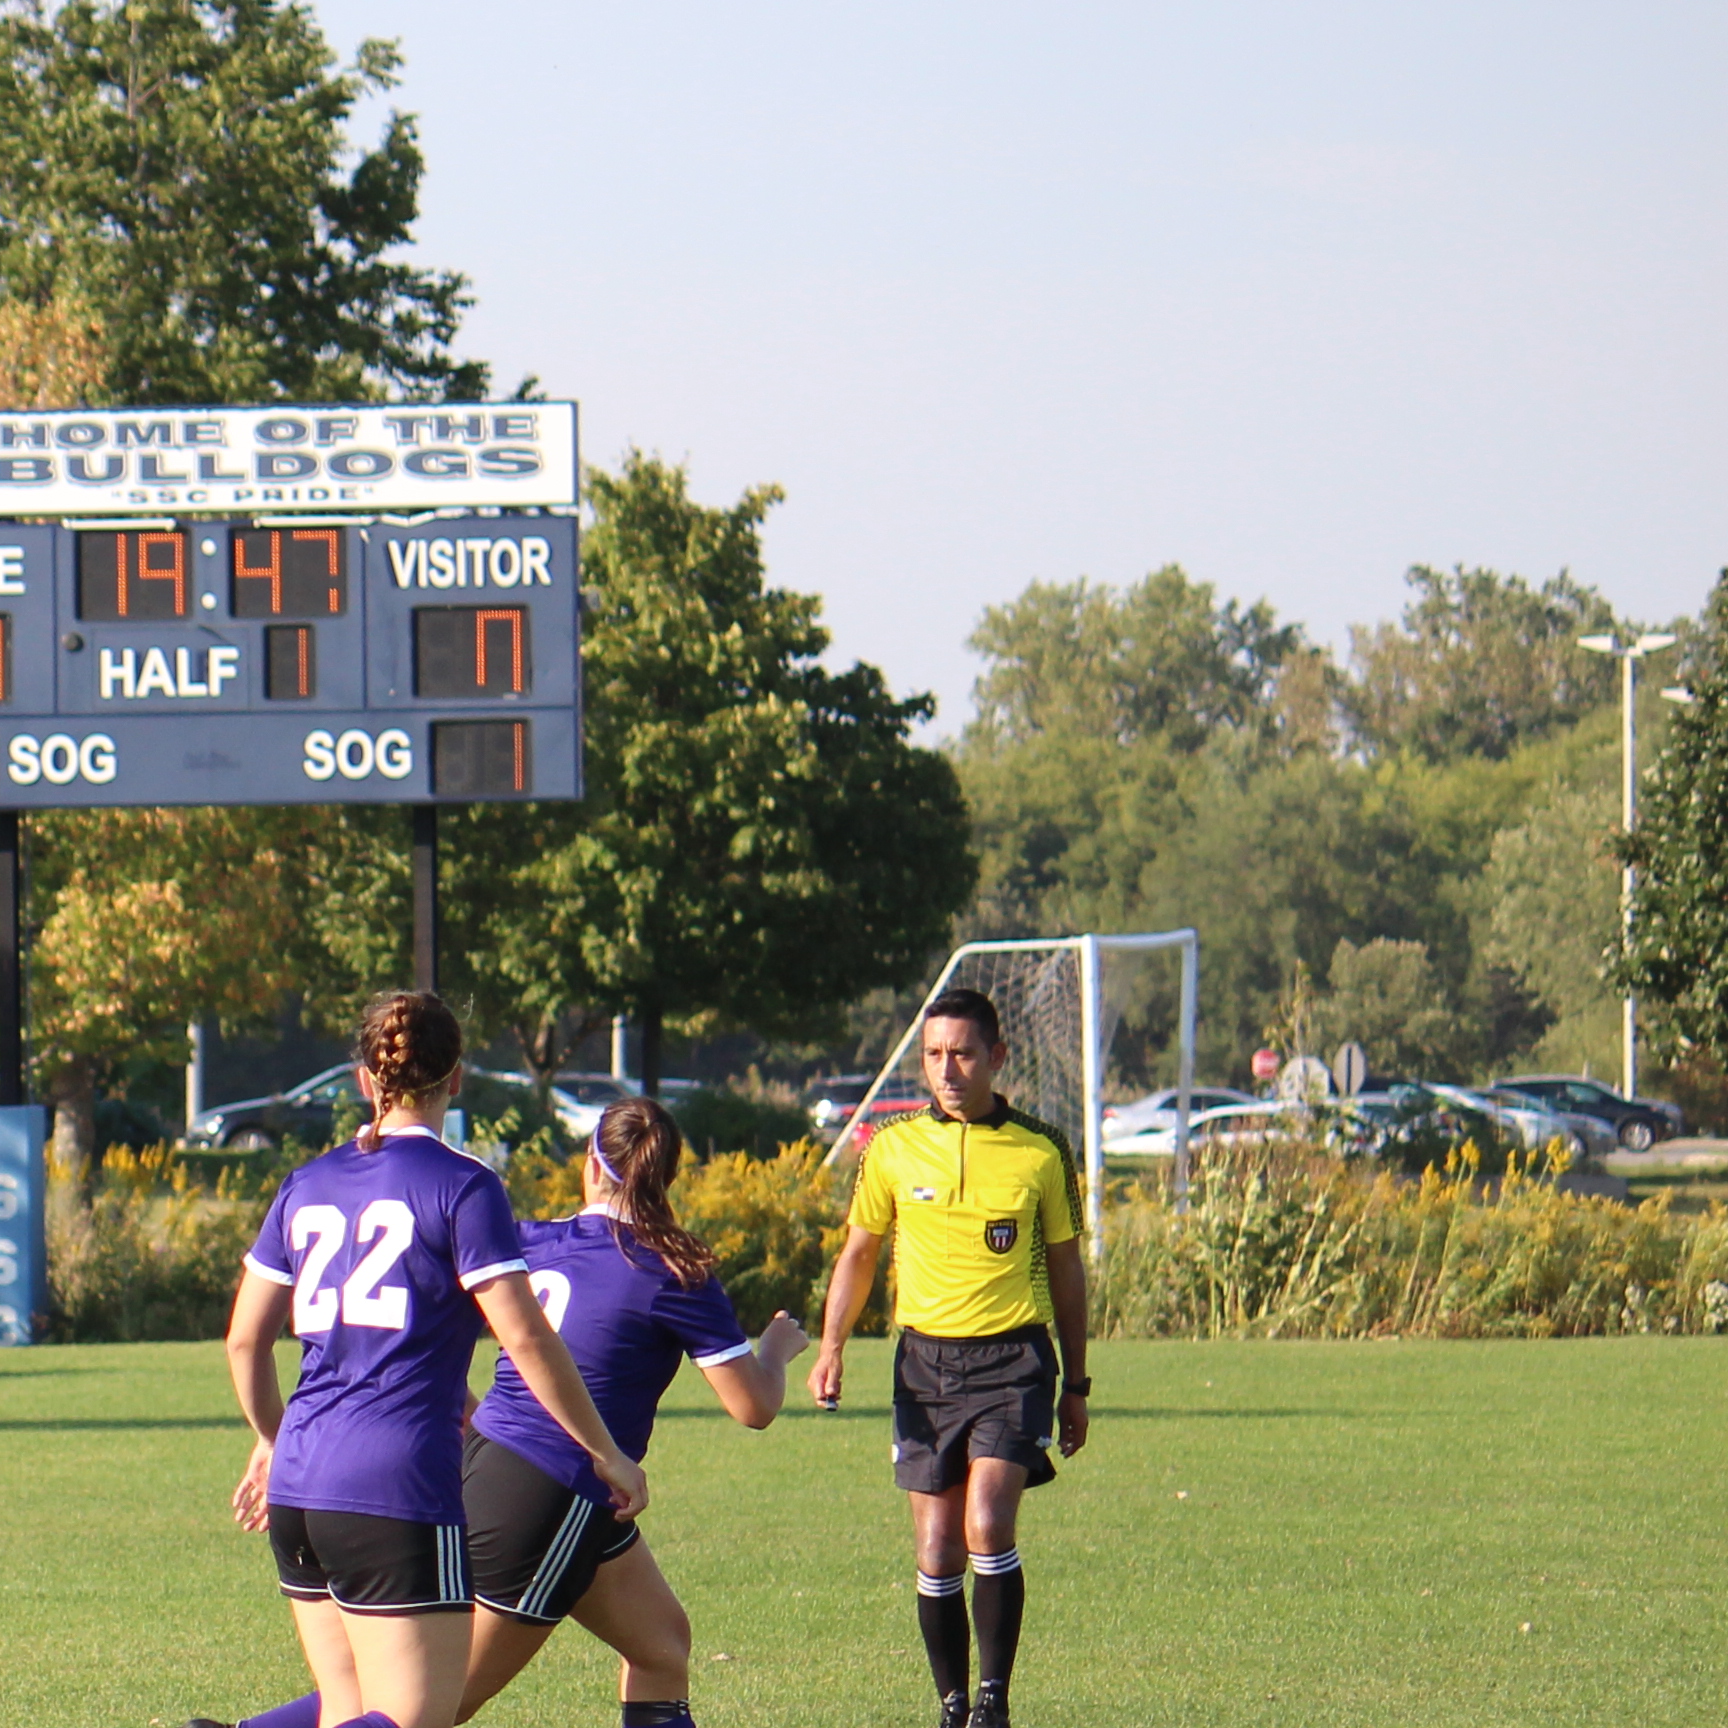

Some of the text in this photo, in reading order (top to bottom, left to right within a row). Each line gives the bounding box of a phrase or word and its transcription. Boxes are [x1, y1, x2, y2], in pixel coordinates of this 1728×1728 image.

[253, 415, 360, 446] OF
[383, 412, 540, 443] THE
[387, 536, 553, 589] VISITOR
[99, 646, 240, 699] HALF
[298, 628, 308, 696] 1
[7, 733, 117, 785] SOG
[302, 728, 413, 781] SOG
[513, 722, 523, 791] 1
[290, 1199, 415, 1335] 22
